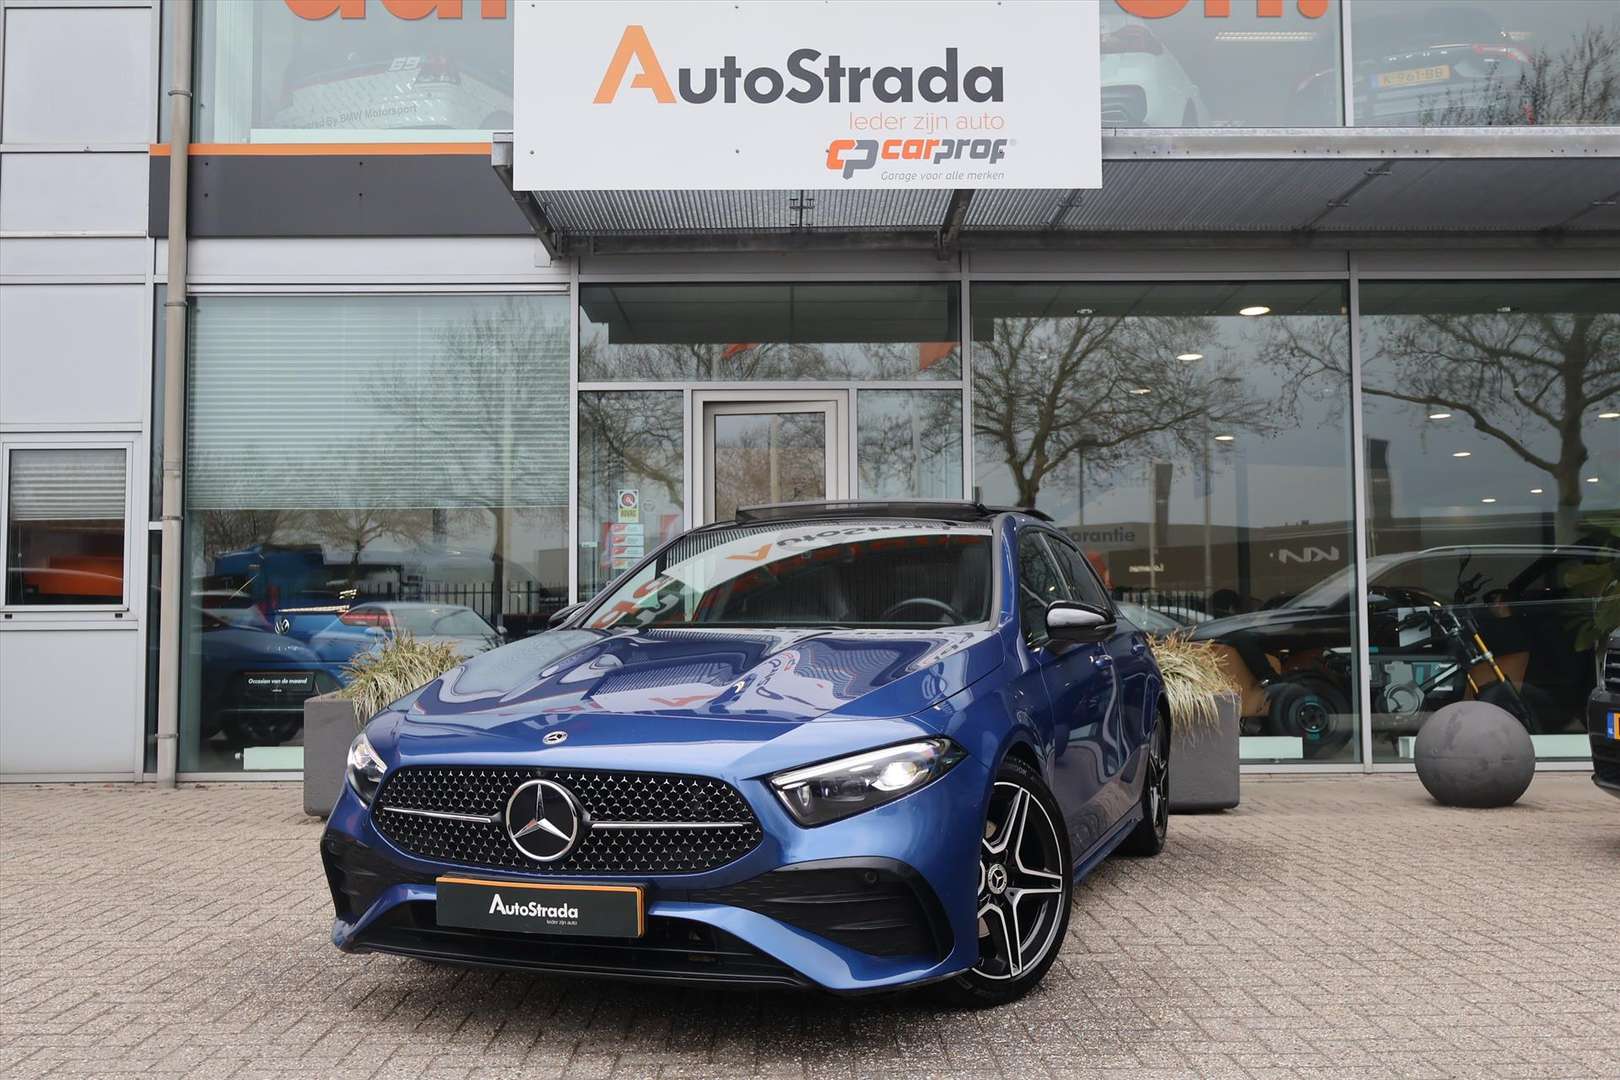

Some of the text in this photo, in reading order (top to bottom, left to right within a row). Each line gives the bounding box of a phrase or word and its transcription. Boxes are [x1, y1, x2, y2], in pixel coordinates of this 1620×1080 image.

[592, 25, 1004, 104] AutoStrada
[850, 111, 1005, 134] Ieder zijn auto
[881, 138, 1007, 164] carprof
[881, 171, 1005, 183] Garage voor alle merken
[489, 893, 578, 919] AutoStrada
